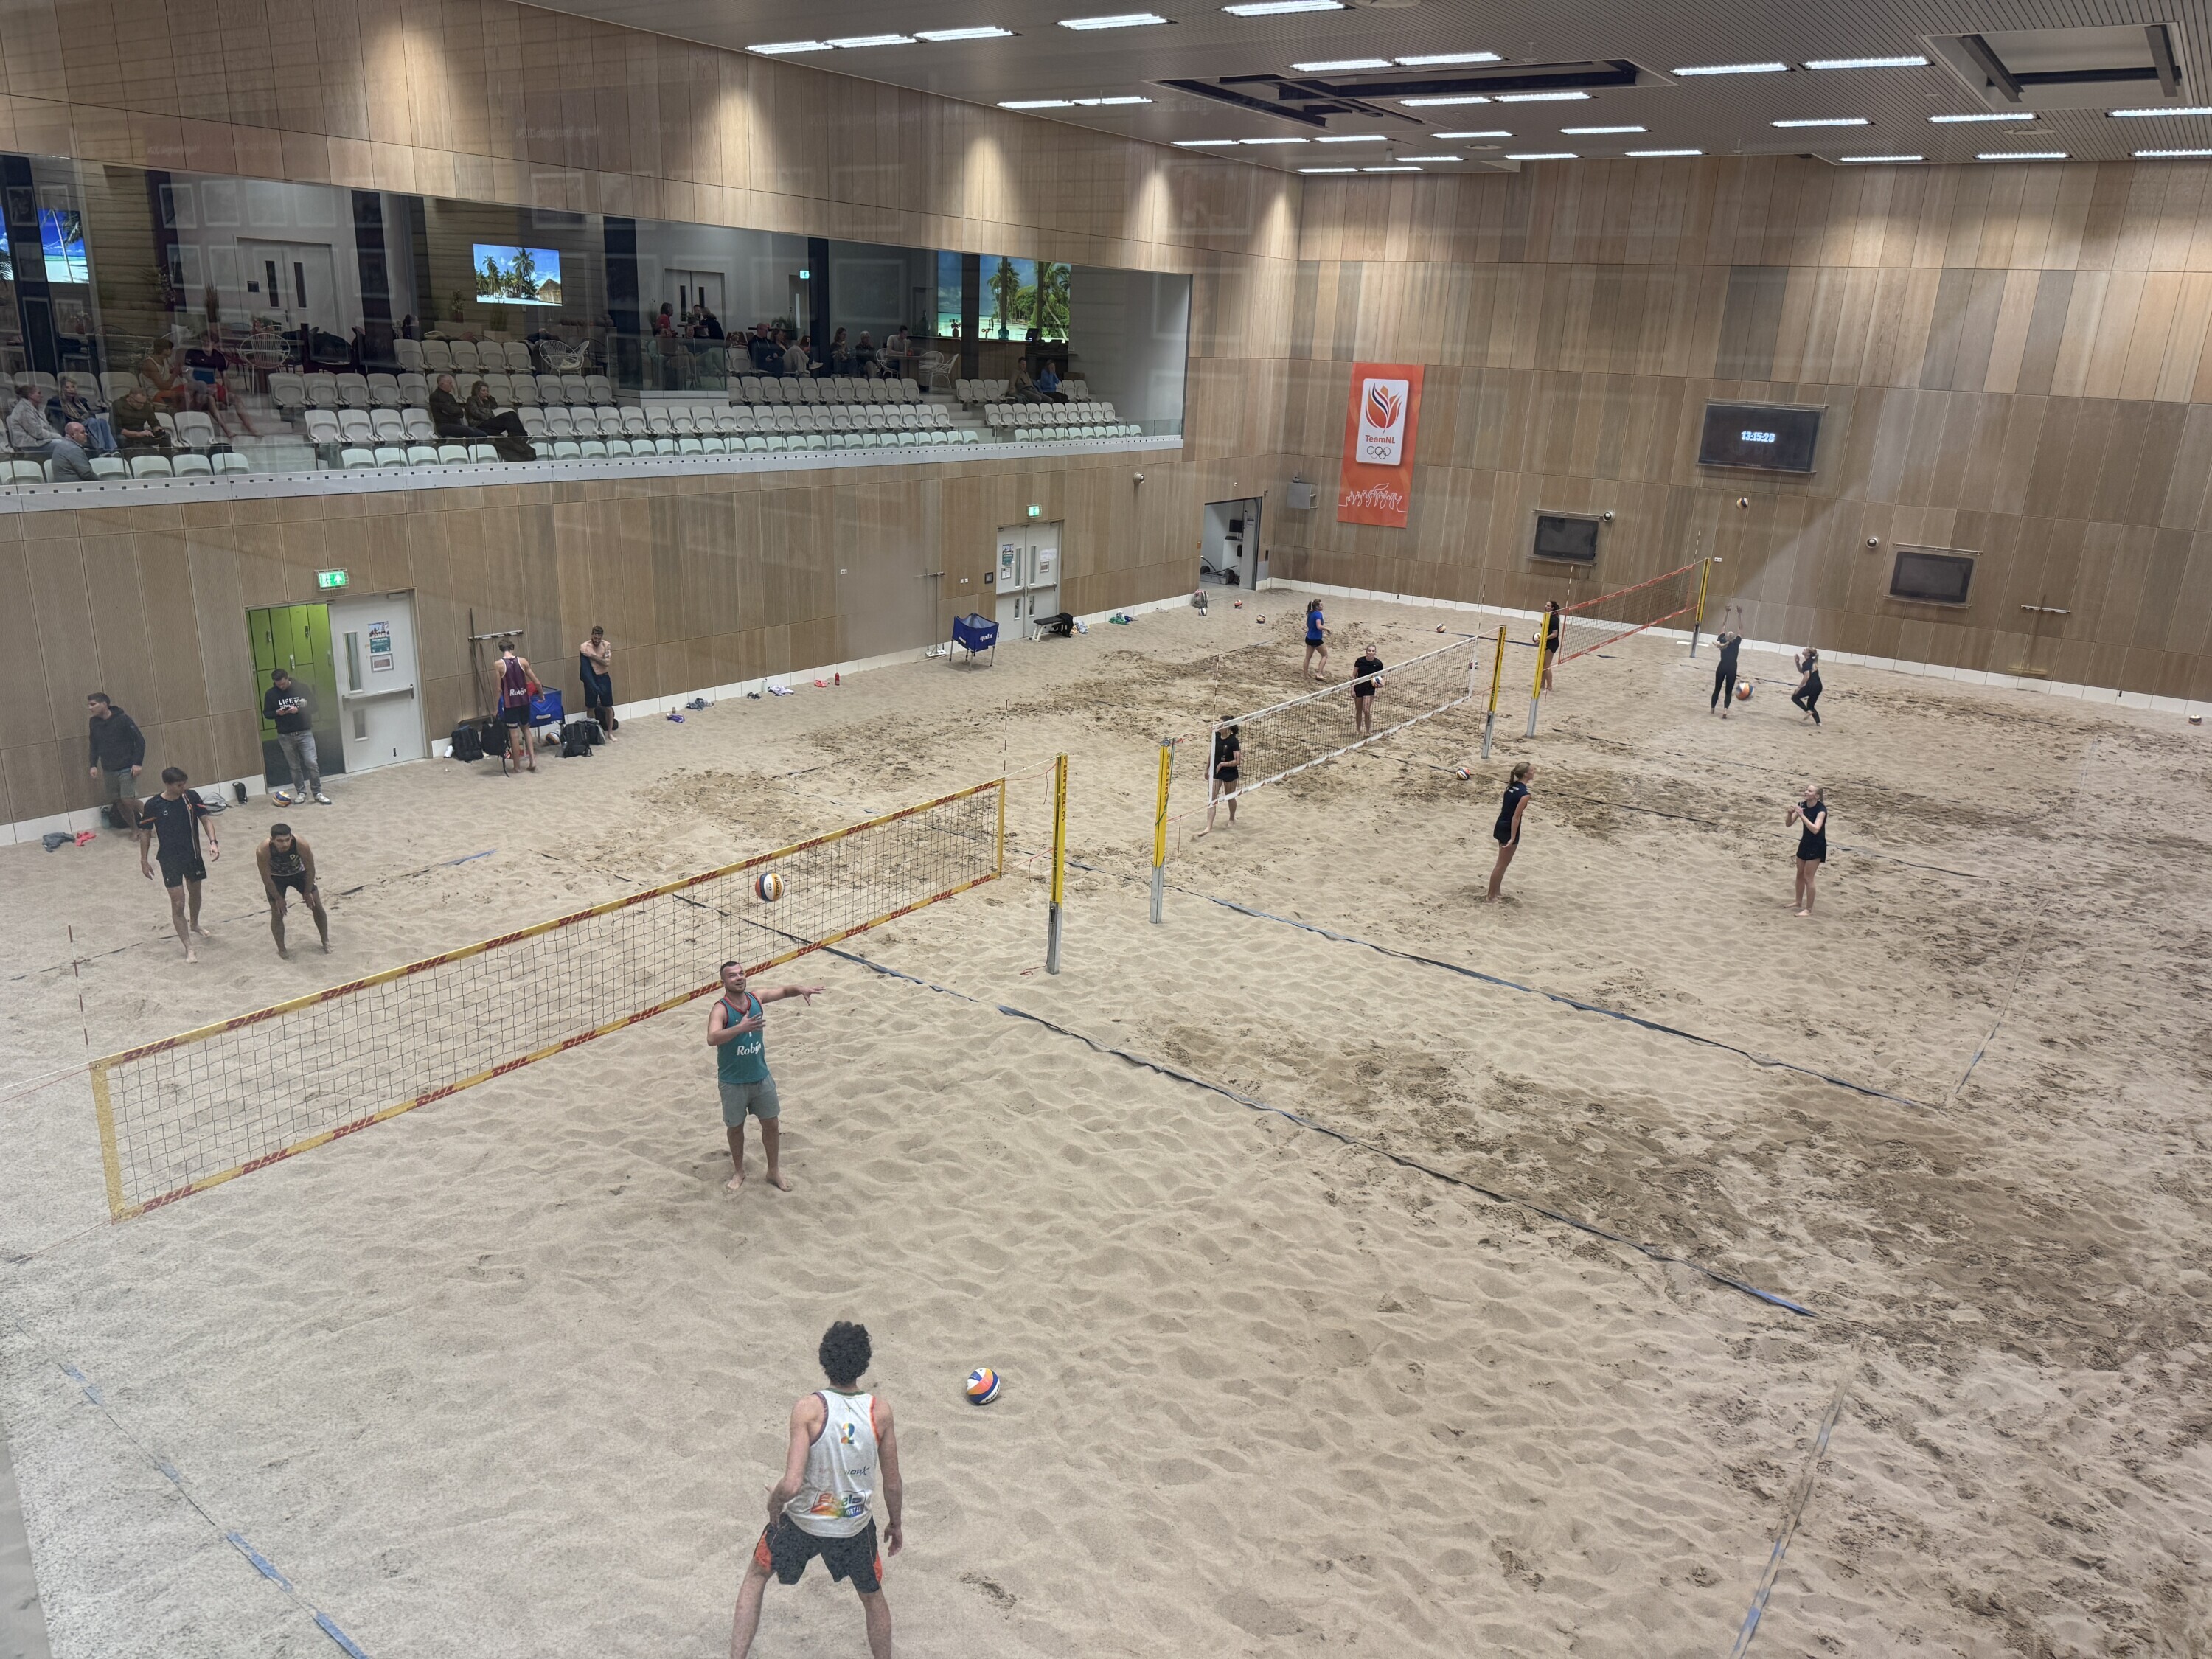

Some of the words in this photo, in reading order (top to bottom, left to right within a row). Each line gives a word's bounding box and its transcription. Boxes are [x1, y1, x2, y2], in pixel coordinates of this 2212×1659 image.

[1366, 434, 1395, 444] TeamNL
[123, 1037, 176, 1062] DHL
[226, 1008, 274, 1030] DHL
[319, 980, 364, 1001] DHL
[406, 955, 447, 973] DHL
[485, 932, 522, 950] DHL
[559, 909, 594, 927] DHL
[626, 889, 658, 905] DHL
[688, 871, 718, 886] DHL
[745, 853, 773, 868] DHL
[797, 838, 824, 851] DHL
[847, 822, 871, 835] DHL
[892, 807, 914, 820] DHL
[935, 794, 956, 806] DHL
[975, 782, 995, 793] DHL
[143, 1184, 193, 1213] DHL
[242, 1148, 288, 1175] DHL
[333, 1115, 375, 1141] DHL
[415, 1085, 454, 1106] DHL
[492, 1057, 527, 1077] DHL
[562, 1030, 595, 1050] DHL
[628, 1006, 659, 1024] DHL
[689, 981, 720, 1000] DHL
[745, 960, 773, 978] DHL
[797, 941, 822, 957] DHL
[845, 923, 869, 938] DHL
[890, 905, 912, 919] DHL
[932, 889, 953, 903] DHL
[971, 874, 991, 888] DHL
[841, 1423, 855, 1444] 2
